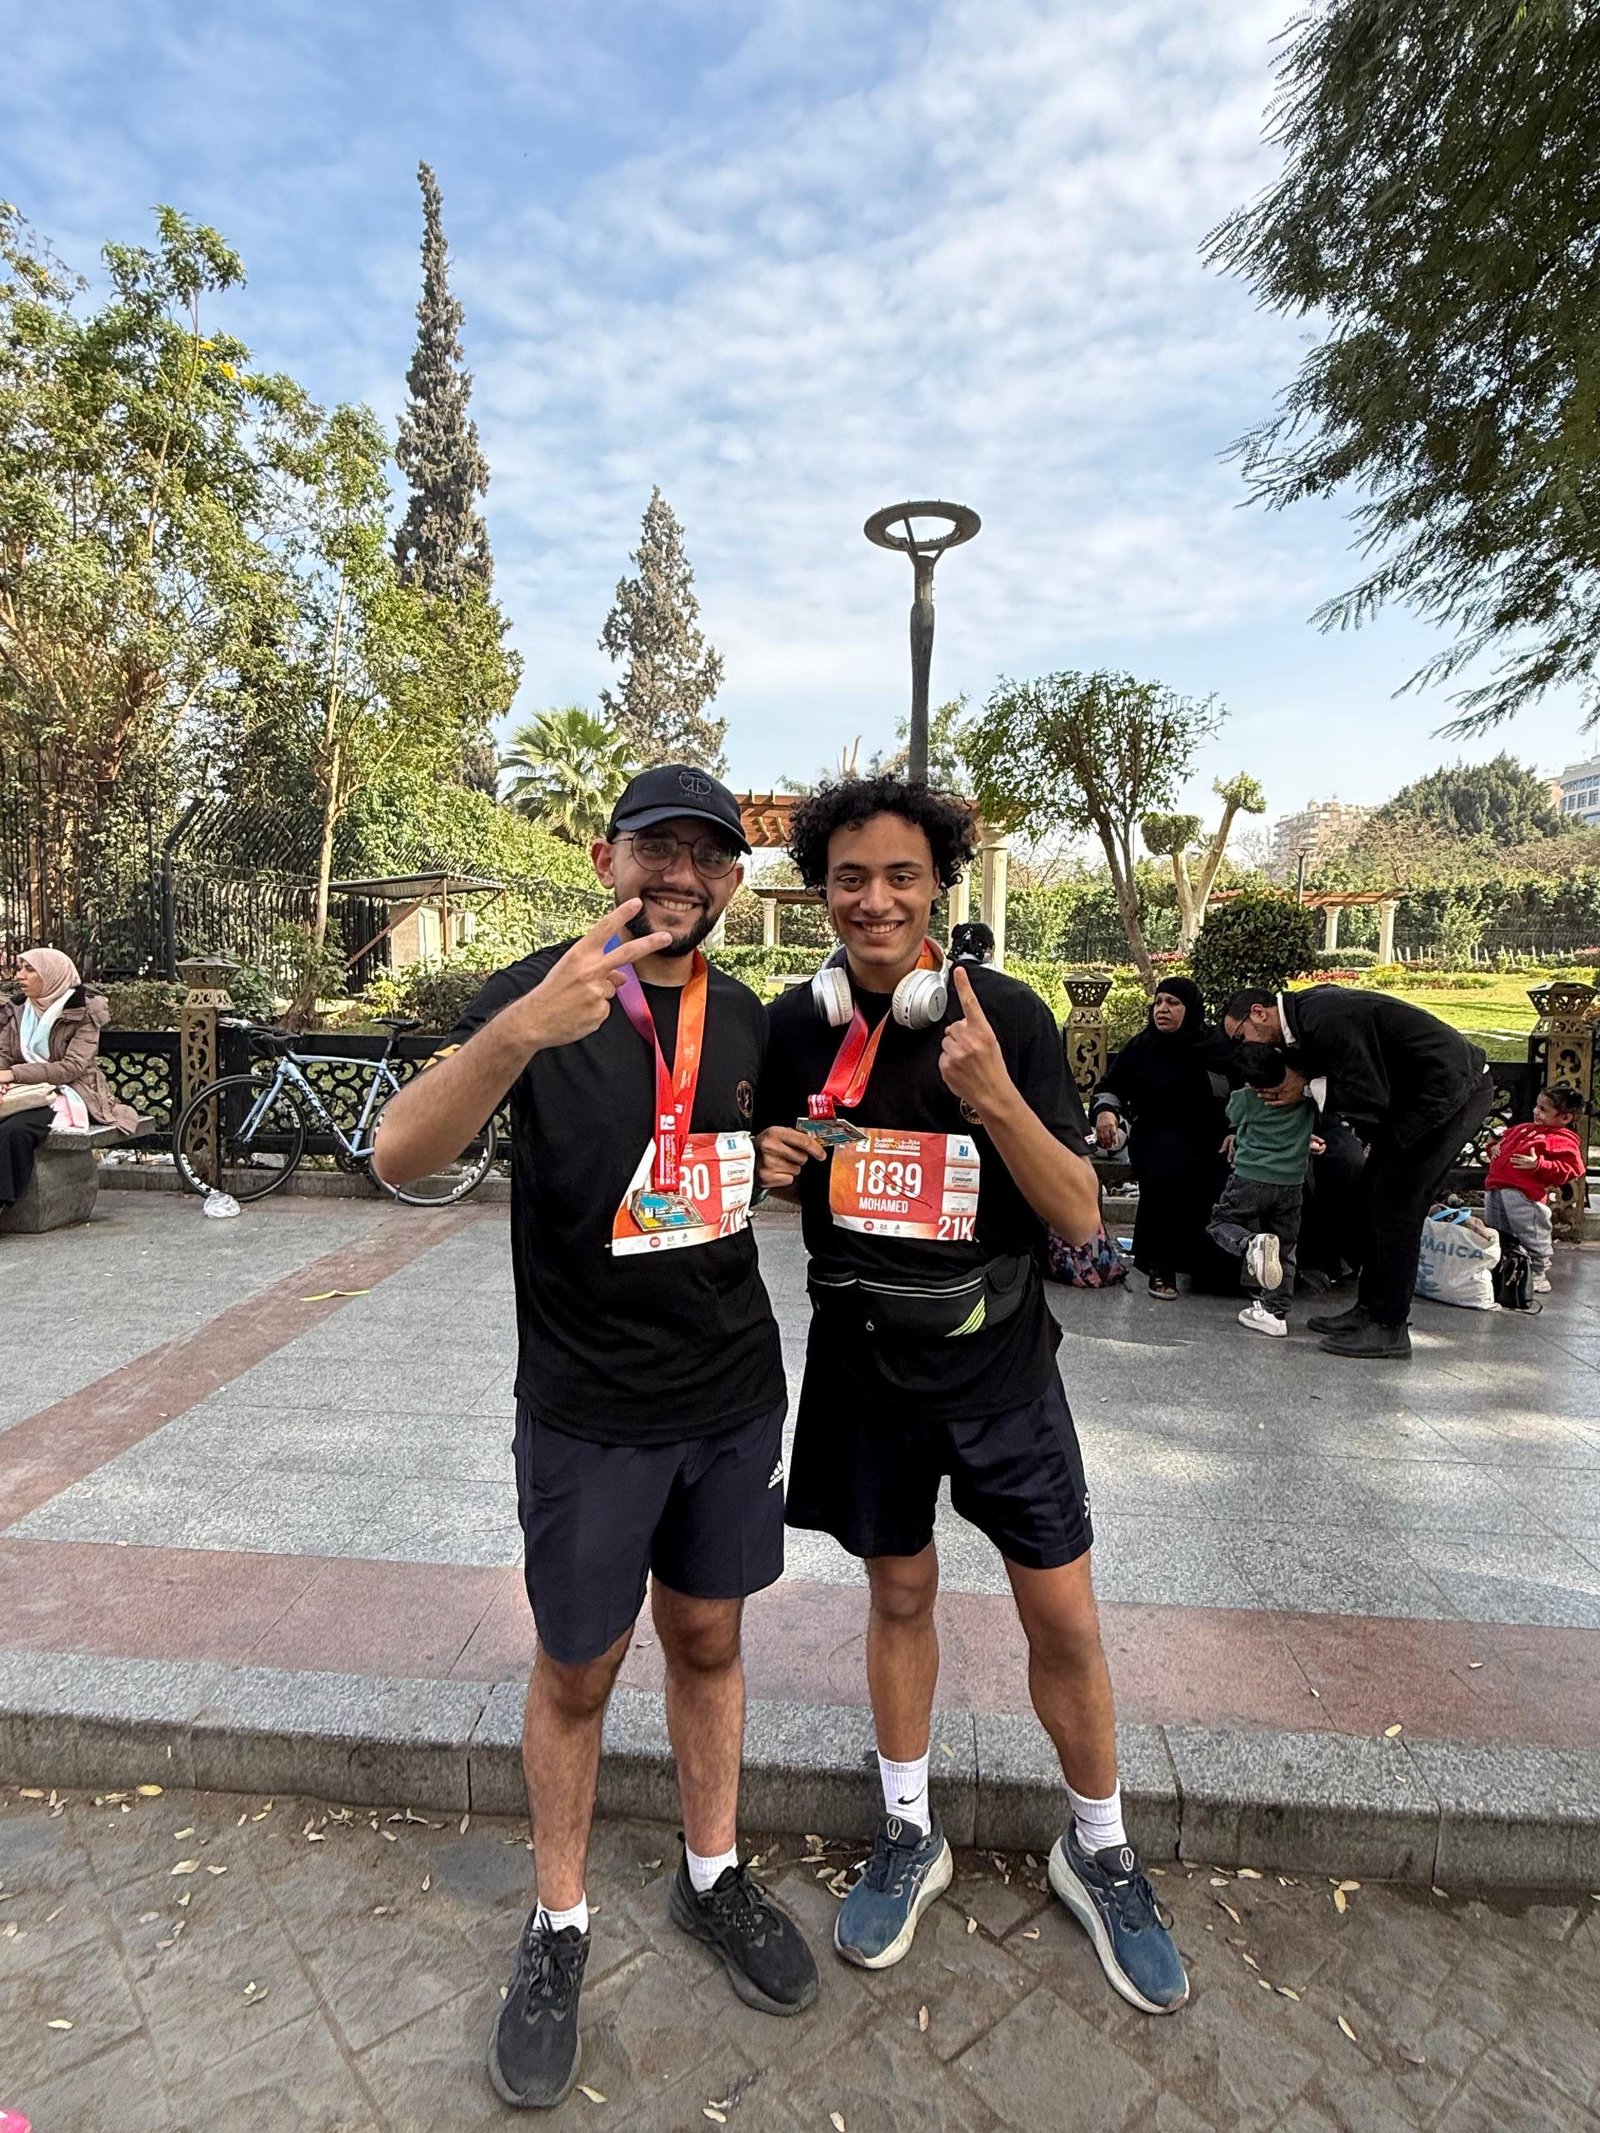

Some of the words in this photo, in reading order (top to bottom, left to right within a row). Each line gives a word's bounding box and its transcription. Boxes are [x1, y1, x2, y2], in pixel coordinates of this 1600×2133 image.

[854, 1159, 923, 1199] 1839
[859, 1196, 909, 1215] MOHAMED
[936, 1215, 976, 1242] 21K
[1420, 1235, 1484, 1260] MAICA
